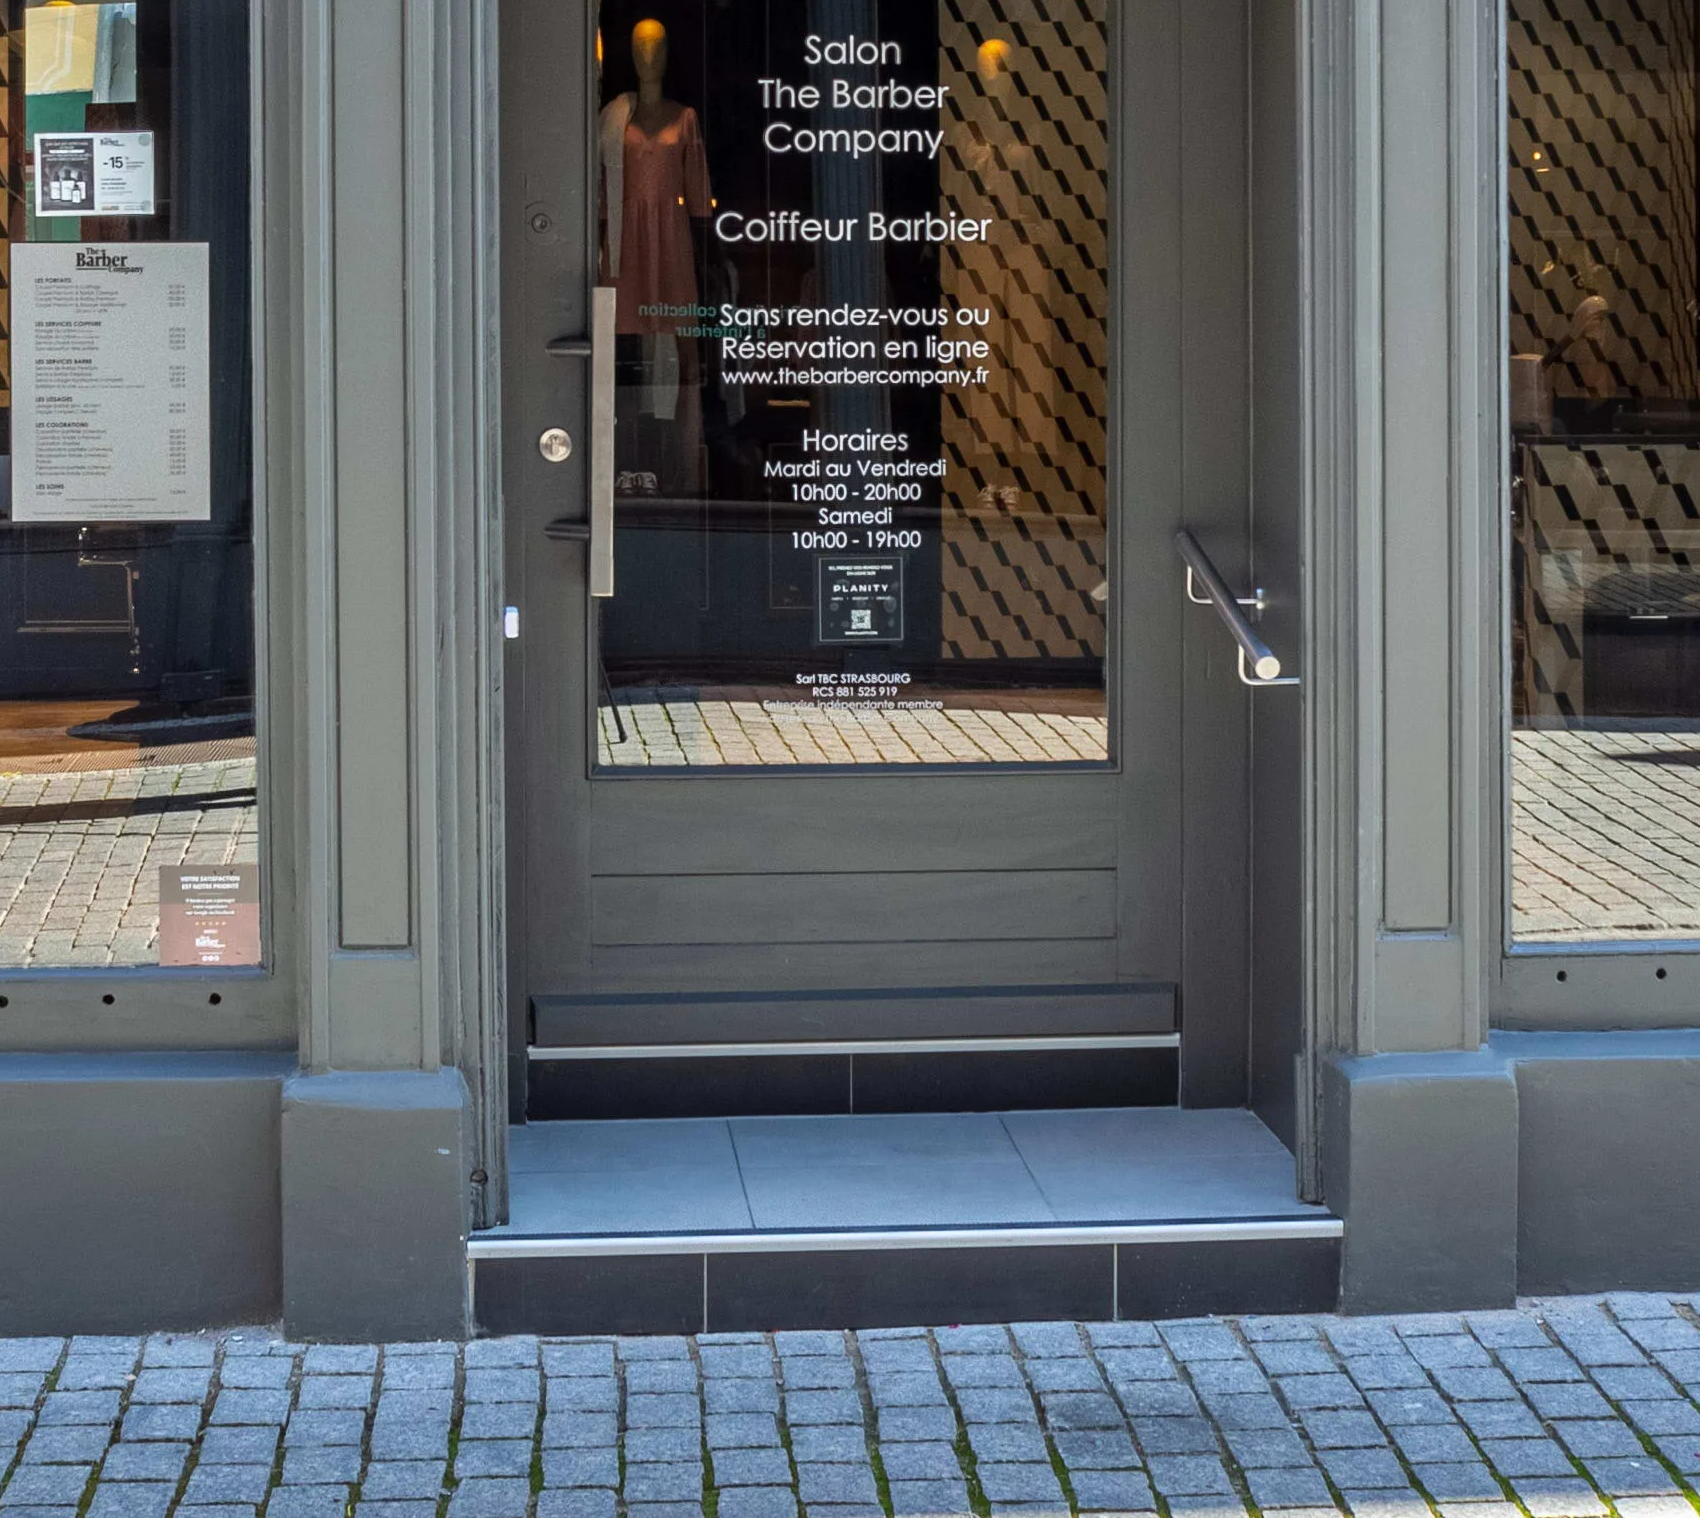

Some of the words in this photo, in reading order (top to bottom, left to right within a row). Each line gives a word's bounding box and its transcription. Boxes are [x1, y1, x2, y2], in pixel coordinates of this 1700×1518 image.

[805, 35, 900, 64] Salon
[758, 79, 820, 108] The
[833, 79, 949, 108] Barber
[765, 124, 944, 159] Company
[716, 211, 858, 241] Coiffeur
[869, 211, 993, 241] Barbier
[76, 251, 127, 267] Barber
[108, 266, 144, 274] Company
[720, 304, 780, 326] Sans
[788, 303, 948, 326] rendez-vous
[956, 308, 989, 325] ou
[723, 335, 875, 359] Réservation
[884, 341, 917, 358] en
[925, 337, 989, 363] ligne
[722, 366, 990, 387] www.thebarbercompany.fr
[804, 428, 908, 451] Horaires
[765, 460, 820, 477] Mardi
[826, 464, 851, 476] au
[857, 459, 946, 476] Vendredi
[793, 484, 847, 500] 10h00
[864, 483, 921, 500] 20h00
[819, 507, 892, 524] Samedi
[793, 531, 847, 548] 10h00
[867, 531, 921, 547] 19h00
[832, 584, 889, 593] PLANITY
[796, 674, 815, 684] Sarl
[817, 674, 839, 684] TBC
[841, 673, 911, 684] STRASBOURG
[812, 687, 834, 696] RCS
[836, 687, 854, 696] 881
[858, 687, 877, 696] 525
[879, 687, 897, 696] 919
[817, 698, 895, 711] indépendante
[897, 700, 944, 709] membre
